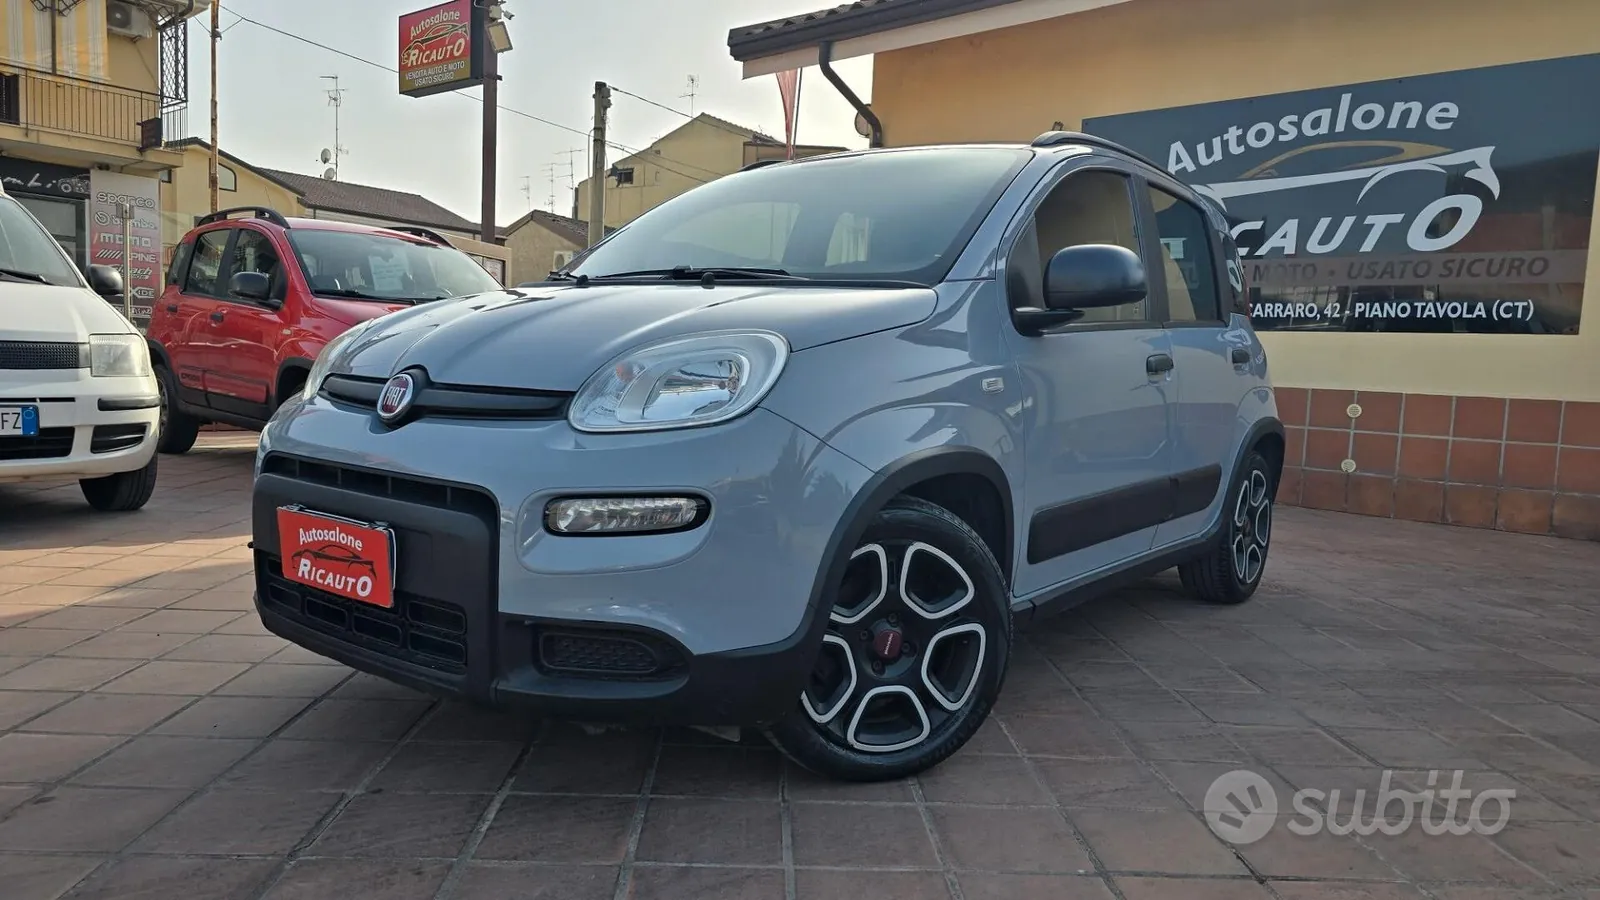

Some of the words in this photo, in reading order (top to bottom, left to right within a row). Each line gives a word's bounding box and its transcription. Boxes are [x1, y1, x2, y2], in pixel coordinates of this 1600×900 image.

[410, 9, 460, 40] Autosalone
[408, 38, 466, 67] RICAUTO
[405, 69, 427, 80] VENDITA
[427, 65, 443, 75] AUTO
[443, 64, 448, 72] E
[448, 60, 465, 70] MOTO
[414, 76, 432, 86] USATO
[432, 72, 455, 83] SICURO
[1166, 93, 1459, 175] Autosalone
[97, 192, 155, 209] sparco
[1230, 194, 1483, 257] CAUTO
[1252, 262, 1317, 282] MOTO
[1347, 259, 1432, 280] USATO
[1438, 256, 1549, 278] SICURO
[1324, 303, 1340, 318] 42
[1354, 302, 1411, 319] PIANO
[1415, 302, 1487, 319] TAVOLA
[1492, 300, 1534, 321] (CT)
[383, 386, 406, 406] FIAT
[299, 527, 363, 551] Autosalone
[298, 558, 373, 597] RICAUTO
